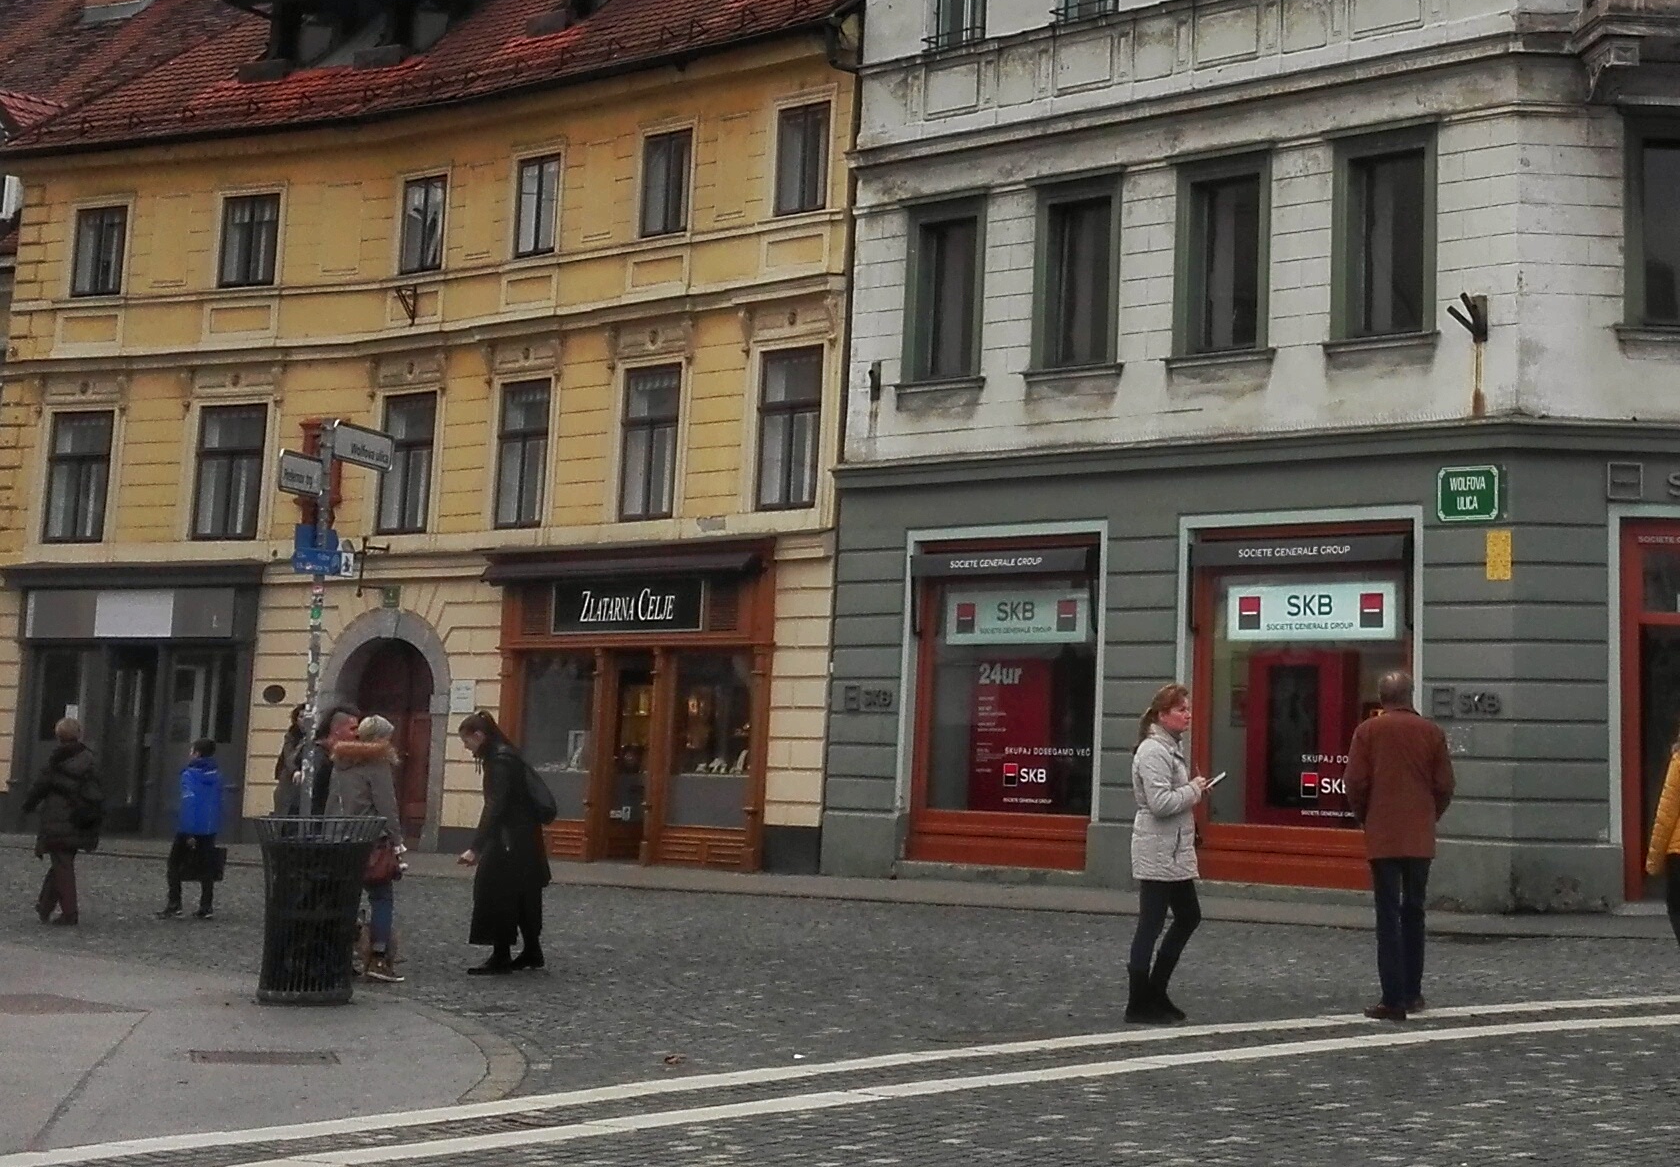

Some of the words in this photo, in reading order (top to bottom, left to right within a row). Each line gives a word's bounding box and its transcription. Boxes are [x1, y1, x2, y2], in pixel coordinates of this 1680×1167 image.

[1449, 476, 1486, 491] WOLFOVA
[1456, 496, 1478, 510] ULICA
[1638, 535, 1675, 544] SOCIETE
[1238, 548, 1273, 558] SOCIETE
[1274, 546, 1318, 557] GENERALE
[1320, 545, 1351, 554] GROUP
[950, 559, 978, 569] SOCIETE
[979, 557, 1016, 568] GENERALE
[1016, 556, 1043, 566] GROUP
[579, 590, 634, 622] ZLATARNA
[637, 588, 676, 621] CELJE
[996, 601, 1036, 622] SKB
[1286, 594, 1333, 617] SKB
[1266, 623, 1293, 631] SOCIETE
[1294, 623, 1329, 631] GENERALE
[1330, 622, 1354, 630] GROUP
[978, 663, 1023, 685] 24ur
[863, 689, 893, 708] SKB
[1459, 692, 1501, 714] SKB
[1004, 746, 1031, 755] SKUPAJ
[1033, 747, 1074, 756] DOSEGAMO
[1075, 747, 1091, 757] VEČ
[1301, 754, 1334, 764] SKUPAJ
[1020, 768, 1047, 783] SKB
